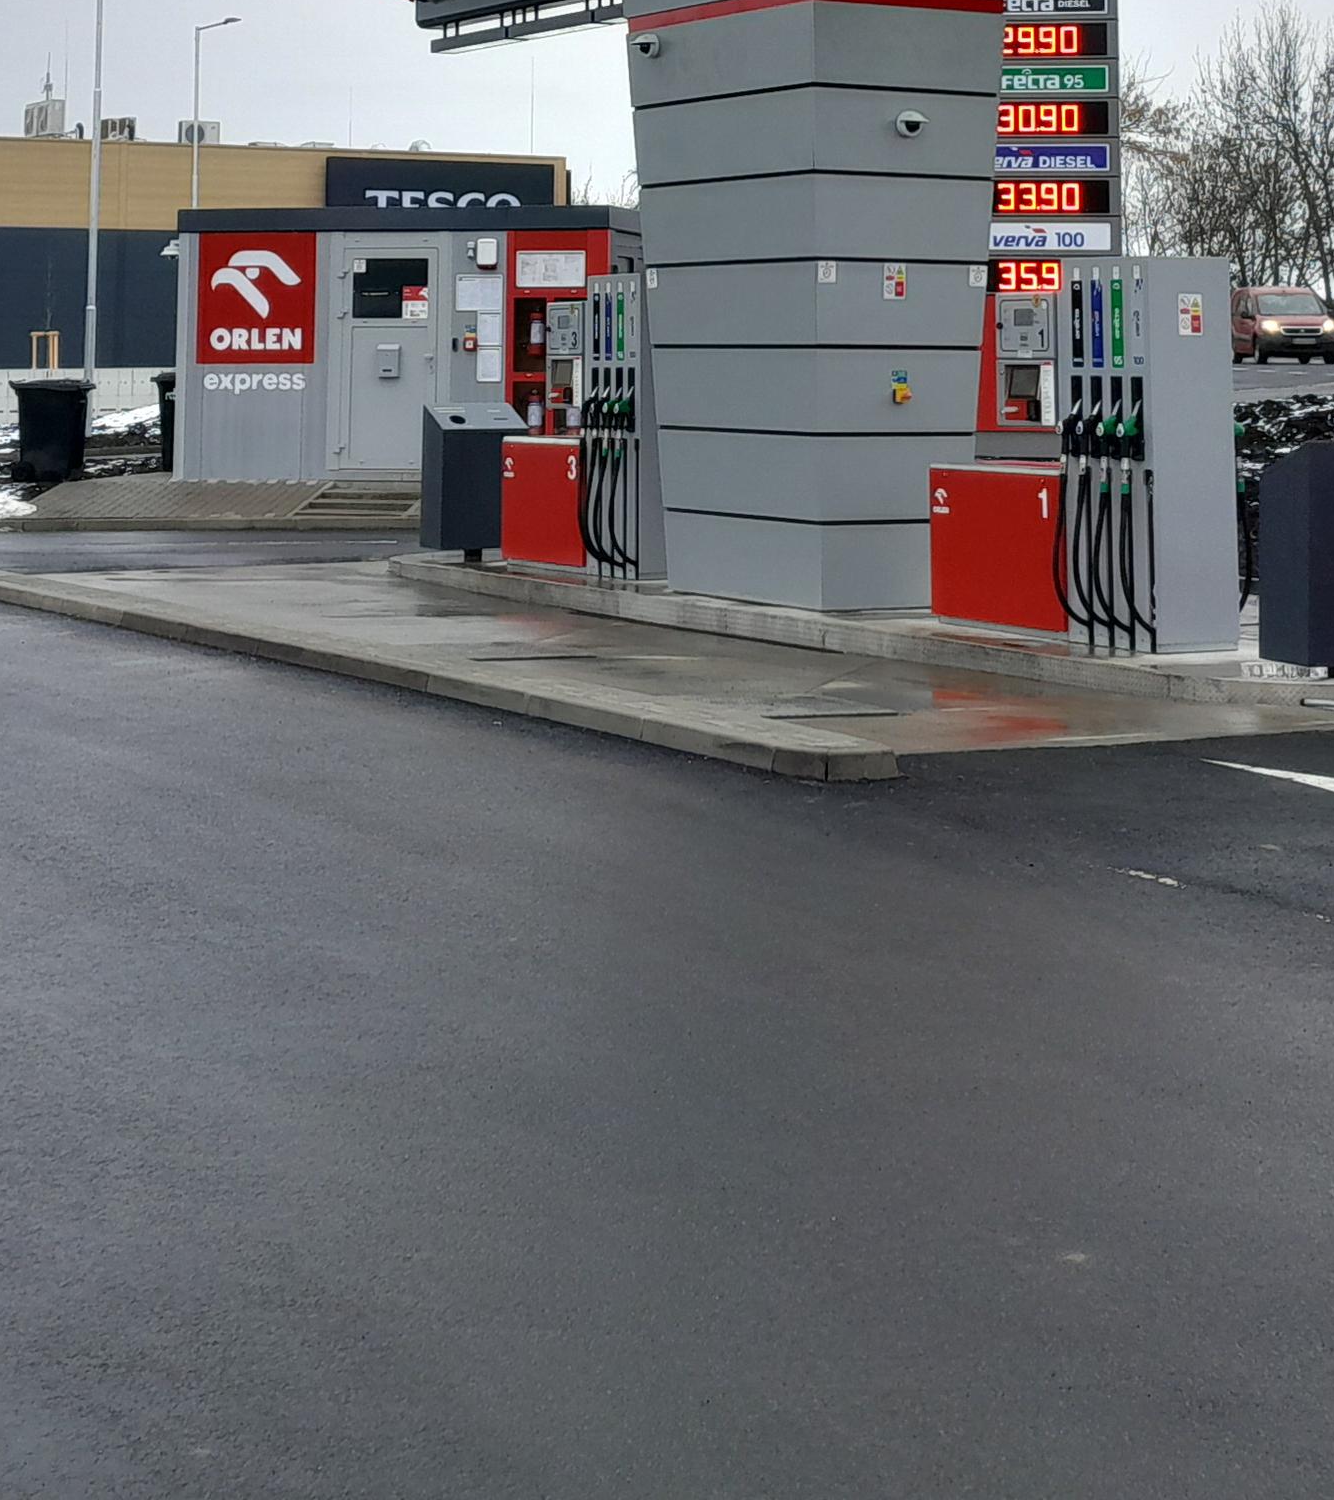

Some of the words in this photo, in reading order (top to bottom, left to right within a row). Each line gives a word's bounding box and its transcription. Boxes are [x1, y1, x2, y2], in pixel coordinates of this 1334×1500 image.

[1057, 0, 1091, 8] DIESEL
[1063, 74, 1085, 88] 95
[997, 105, 1079, 132] 30.90
[1038, 155, 1095, 168] DIESEL
[998, 183, 1080, 211] 33.90
[993, 235, 1048, 248] verva
[1055, 232, 1085, 247] 100
[209, 327, 302, 351] ORLEN
[571, 331, 578, 348] 3
[1038, 328, 1045, 349] 1
[203, 372, 307, 395] express
[567, 455, 577, 480] 3
[1038, 488, 1048, 519] 1
